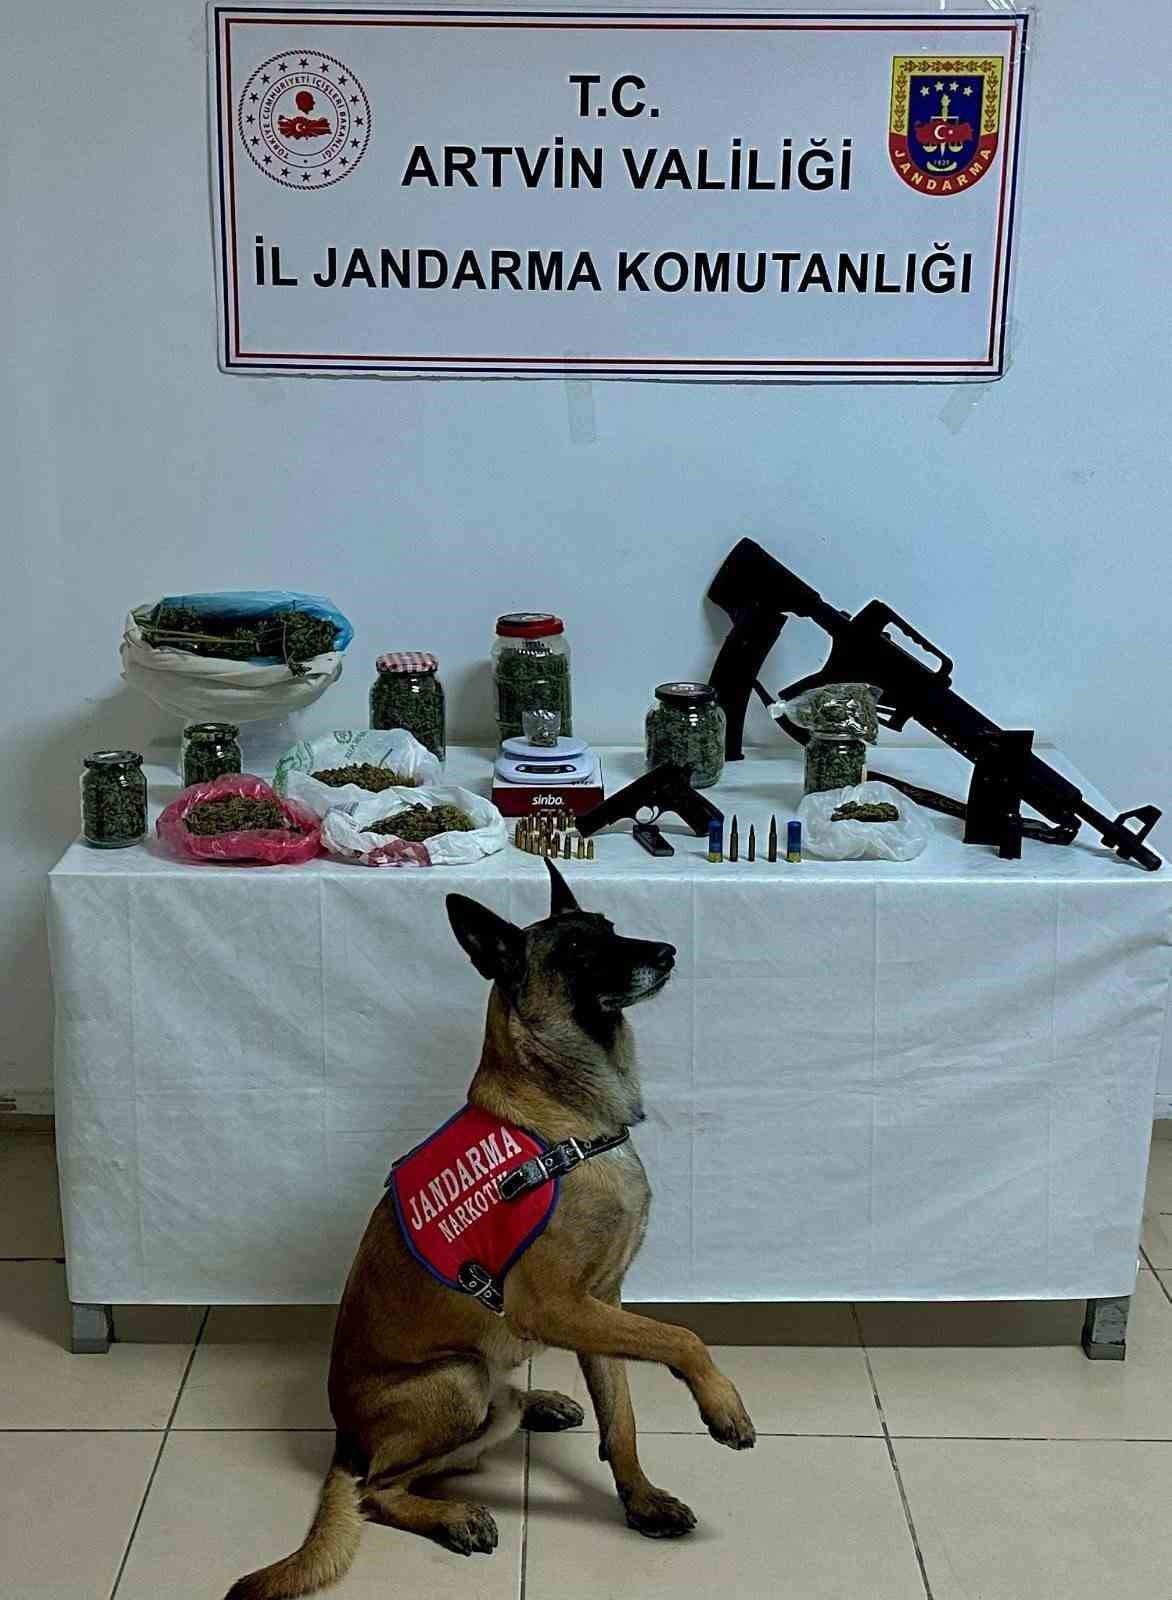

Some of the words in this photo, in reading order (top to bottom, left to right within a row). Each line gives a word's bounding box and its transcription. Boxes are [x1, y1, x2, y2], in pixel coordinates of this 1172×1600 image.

[263, 76, 310, 120] CUMHURİYETİ
[570, 75, 660, 118] T.C.
[402, 137, 603, 189] ARTVİN
[622, 138, 852, 190] VALİLİĞİ
[895, 149, 991, 191] JANDARMA
[256, 235, 298, 286] İL
[313, 246, 603, 291] JANDARMA
[618, 242, 972, 294] KOMUTANLIĞI
[531, 793, 563, 806] sinbo
[409, 1126, 523, 1231] JANDARMA
[437, 1171, 508, 1244] NARKOTİ
